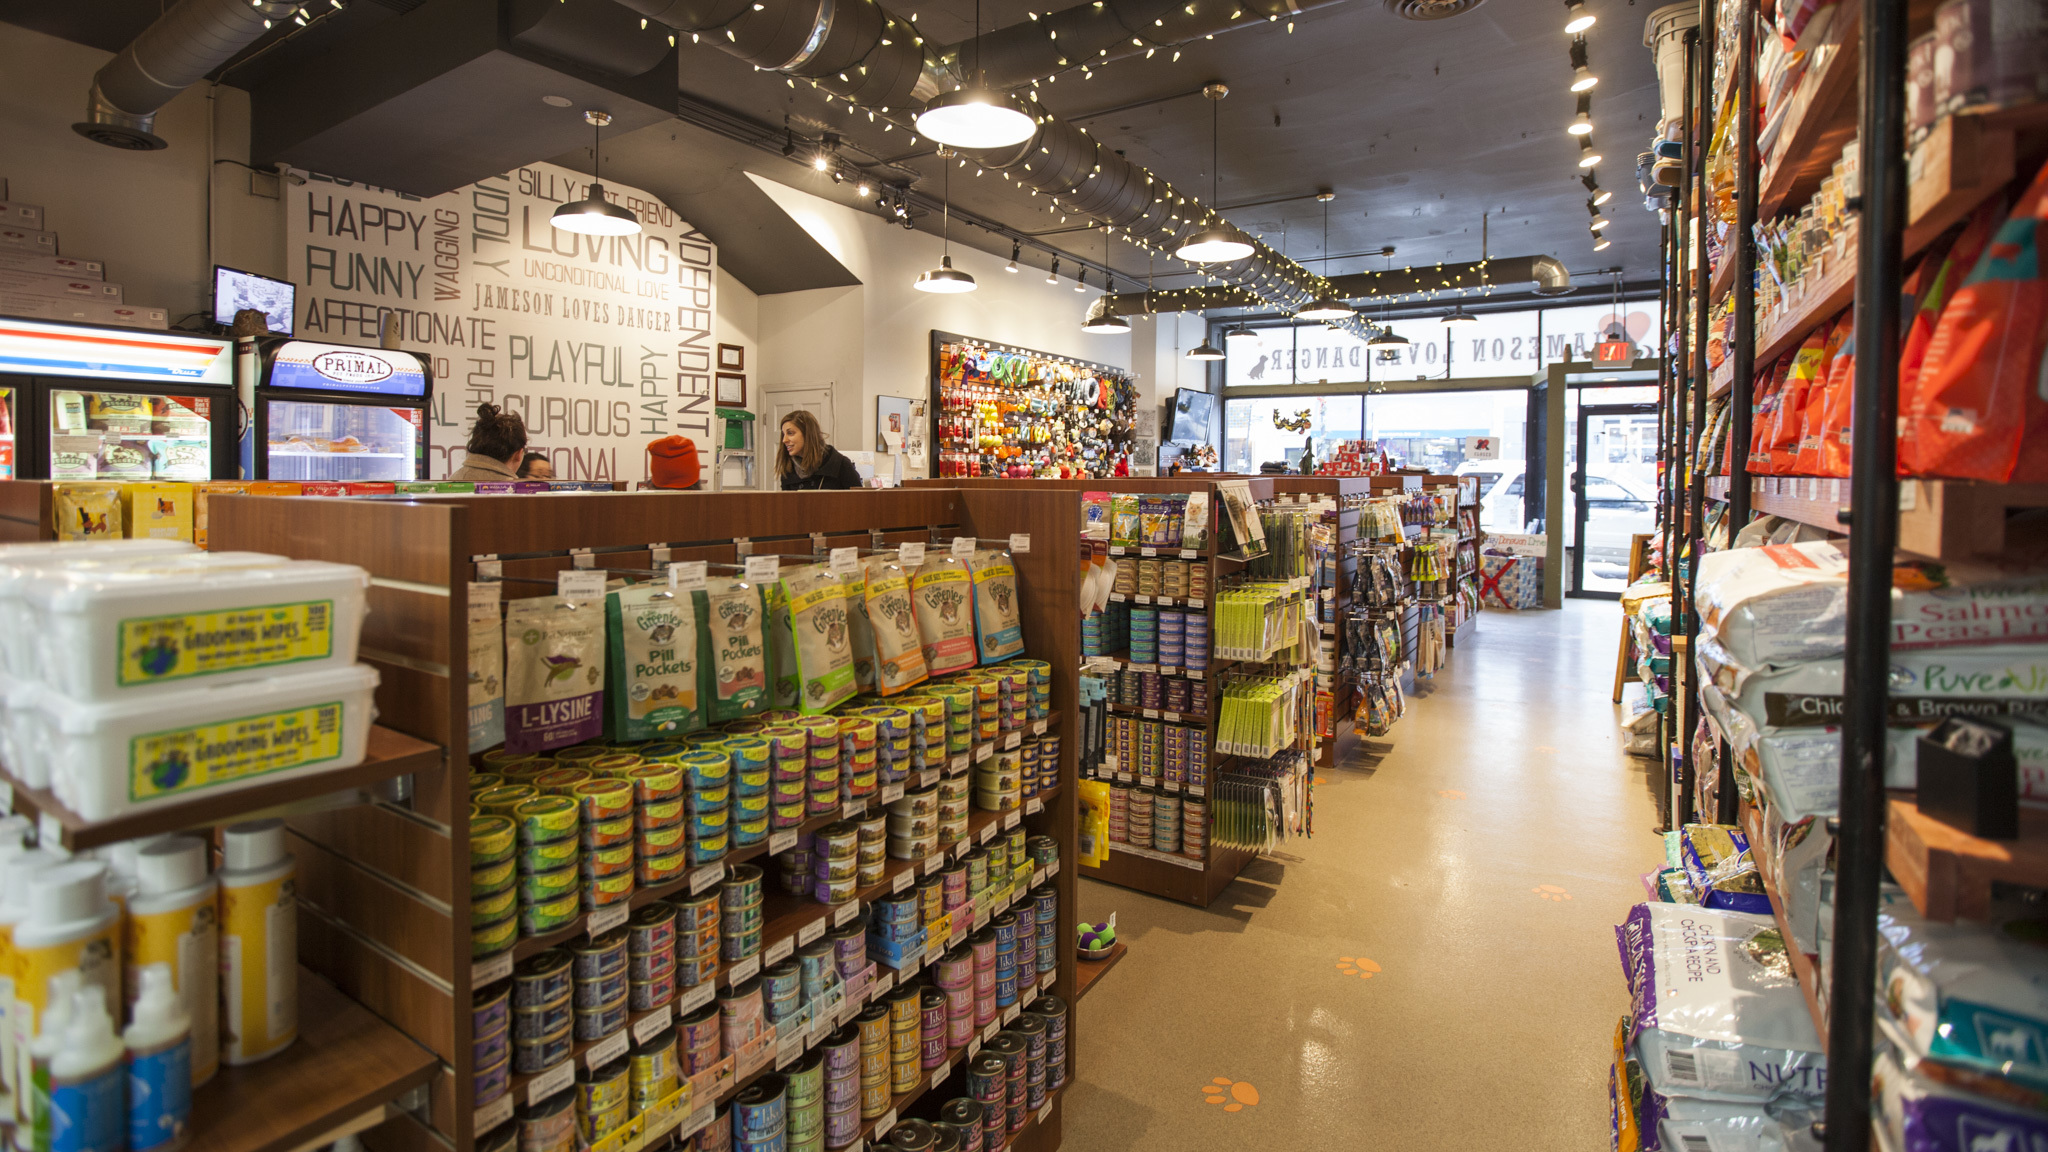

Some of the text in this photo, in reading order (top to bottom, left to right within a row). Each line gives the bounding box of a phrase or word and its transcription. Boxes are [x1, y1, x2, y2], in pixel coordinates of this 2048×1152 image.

[518, 168, 576, 203] SILLY
[308, 191, 427, 250] HAPPY
[472, 173, 510, 277] UDDLY
[626, 195, 673, 228] FRIEND
[434, 208, 460, 301] WAGGING
[522, 205, 670, 275] LOVING
[306, 244, 425, 300] FUNNY
[524, 258, 670, 301] UNCONDITIONAL LOVE
[304, 297, 496, 350] AFFECTIONATE
[473, 283, 672, 332] JAMESON LOVES DANGER
[677, 217, 712, 437] NDEPENDENT
[324, 357, 385, 374] PRIMAL
[509, 334, 634, 388] PLAYFUL
[1600, 342, 1629, 361] EXIT
[640, 344, 669, 435] HAPPY
[503, 394, 631, 438] CURIOUS
[924, 587, 964, 610] Greenies
[184, 626, 257, 650] GROOMING
[261, 621, 298, 641] WIPES
[636, 610, 682, 630] Greenies
[650, 649, 674, 662] Pill
[722, 646, 762, 662] Pockets
[728, 636, 748, 648] Pill
[636, 660, 692, 678] Pockets
[522, 696, 593, 728] L-LYSINE
[1800, 696, 1844, 715] Chic
[195, 735, 268, 762] GROOMING
[273, 727, 309, 747] WIPES
[1686, 956, 1703, 982] RECIPE
[1704, 956, 1721, 974] AND
[1001, 982, 1014, 994] Tiki
[929, 1010, 943, 1025] Tiki
[929, 1040, 942, 1055] Tiki
